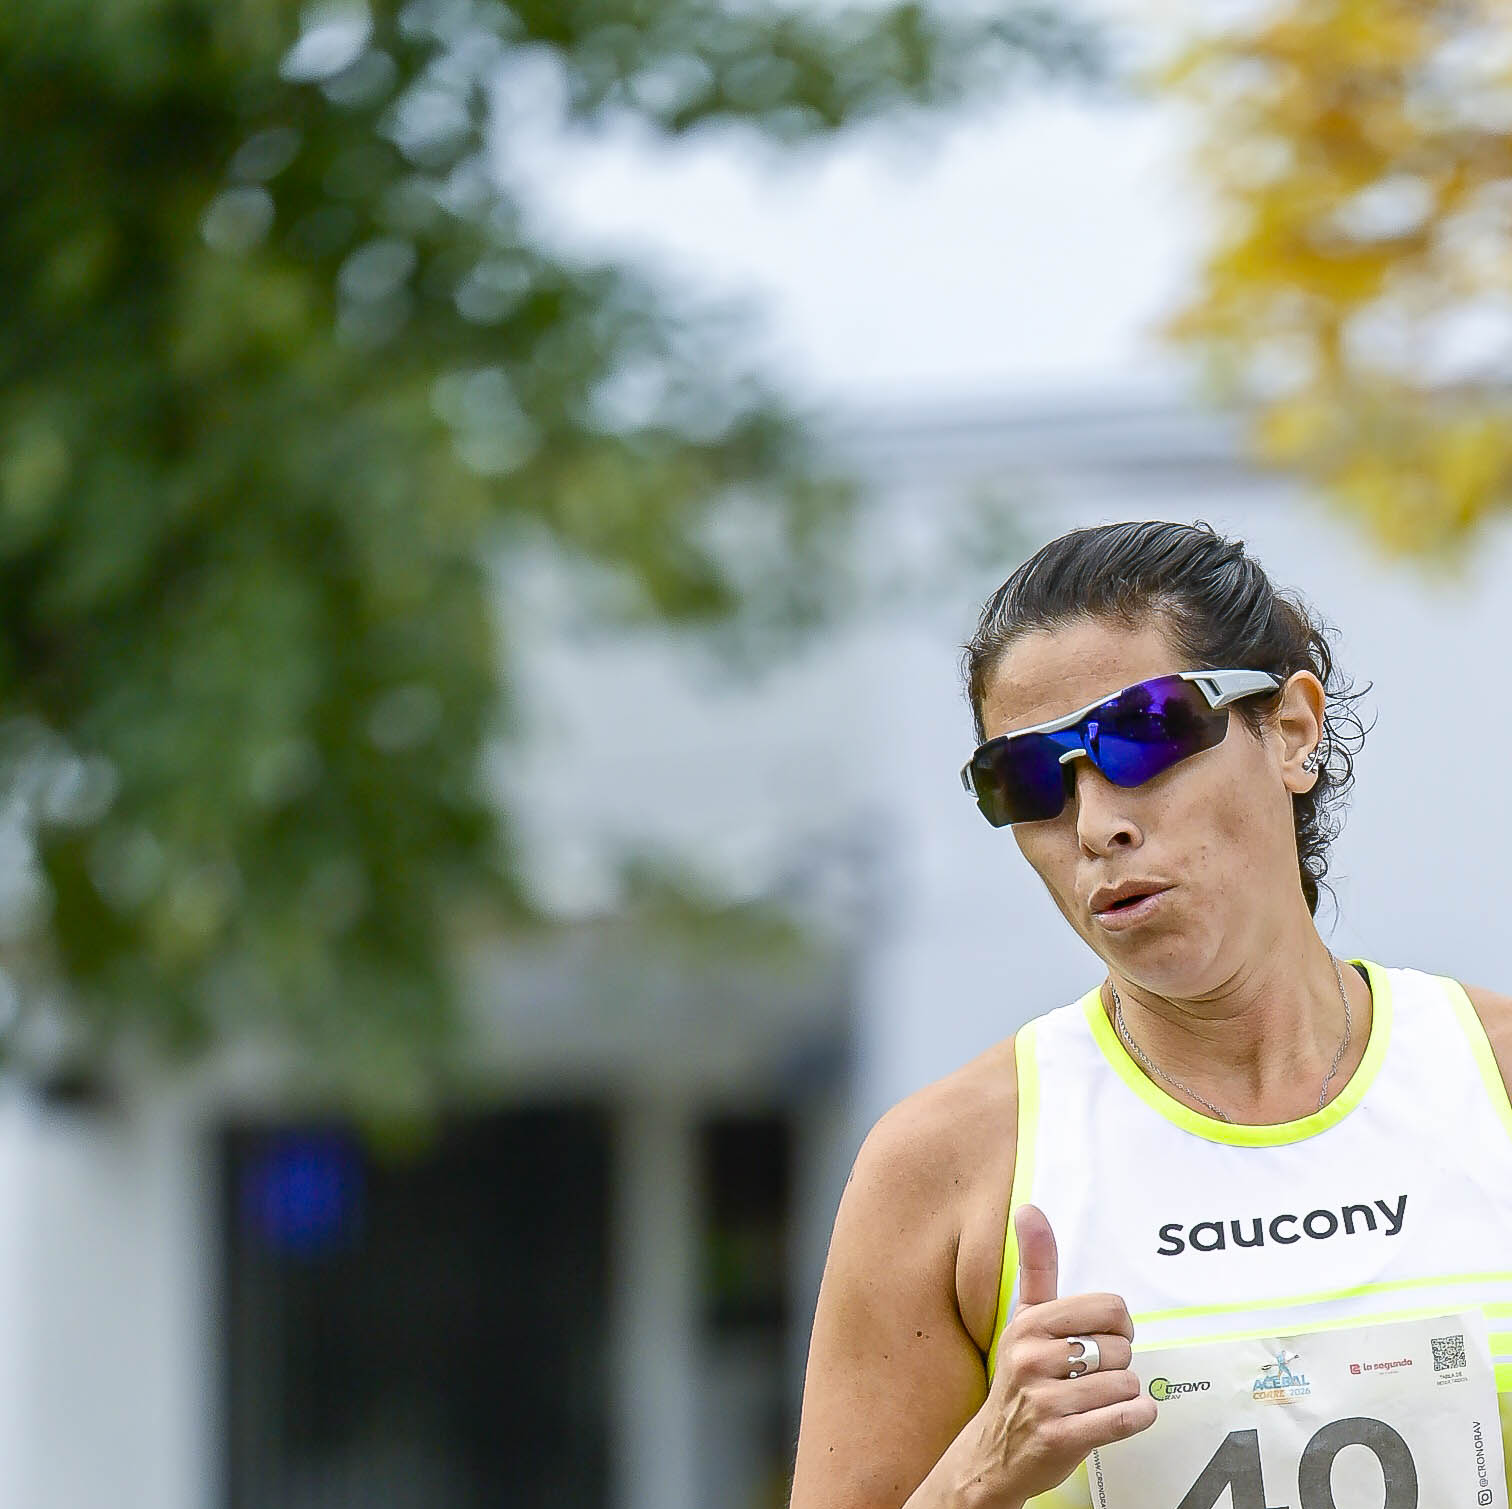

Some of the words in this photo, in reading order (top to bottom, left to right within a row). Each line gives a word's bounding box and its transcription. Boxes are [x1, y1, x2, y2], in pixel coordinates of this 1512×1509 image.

[1157, 1194, 1407, 1257] saucony
[1253, 1374, 1310, 1391] ACEBAL
[1472, 1421, 1489, 1487] @CRONORAV
